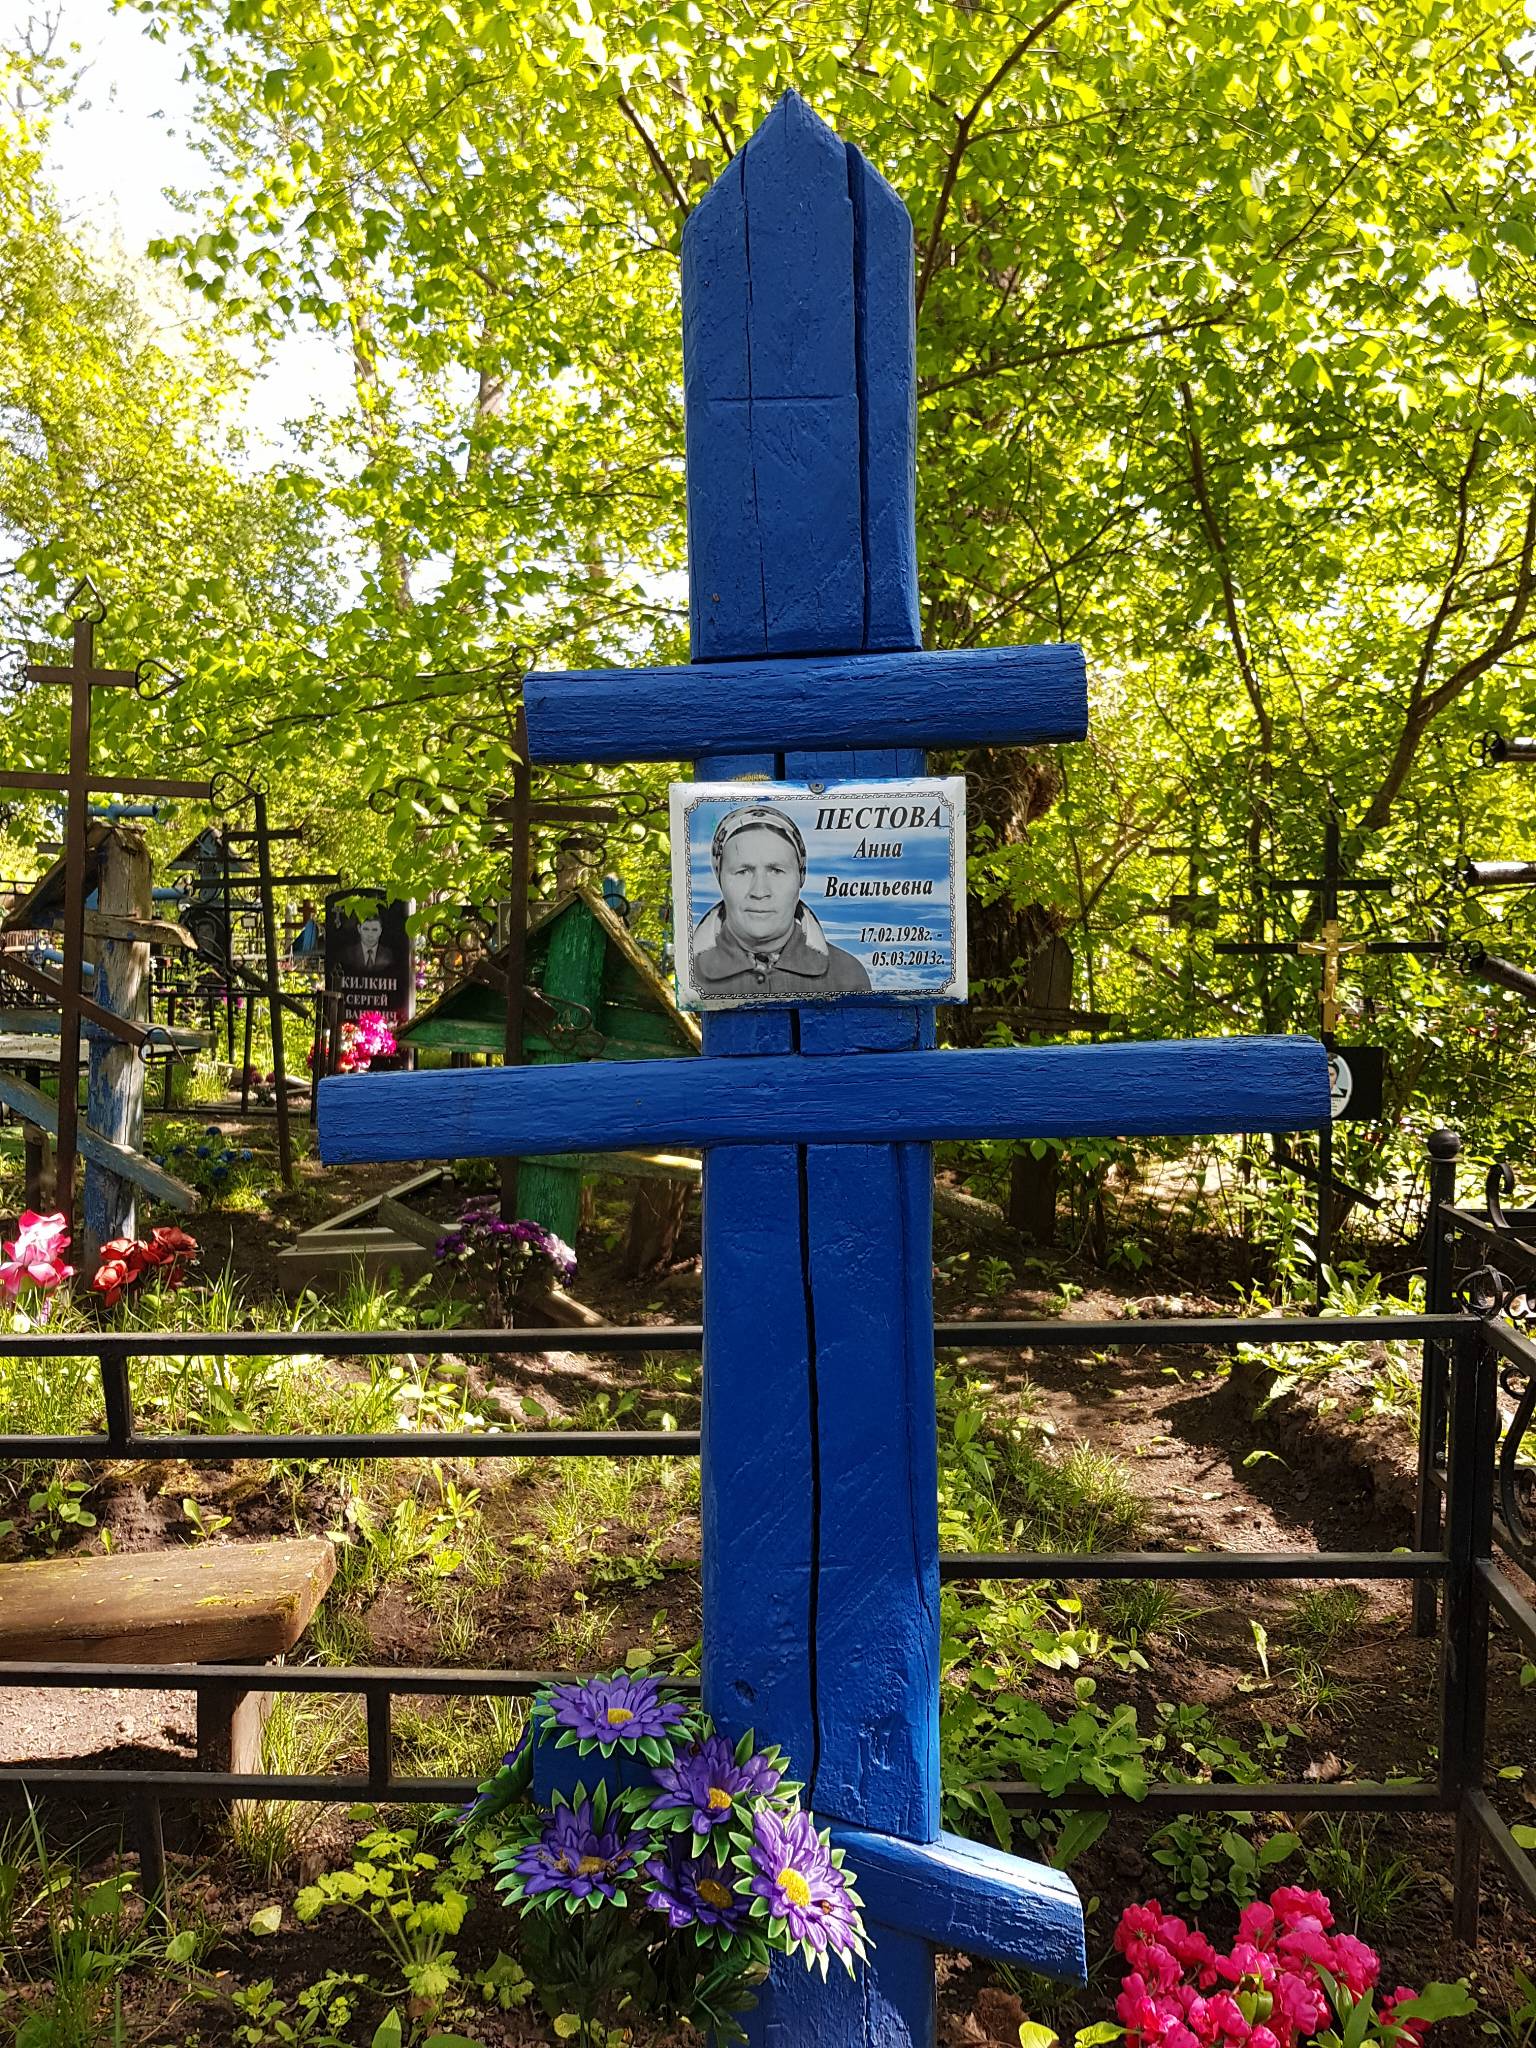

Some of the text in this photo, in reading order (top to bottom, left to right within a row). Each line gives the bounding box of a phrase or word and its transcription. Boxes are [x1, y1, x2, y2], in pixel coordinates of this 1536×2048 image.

[814, 806, 942, 831] ПЕСТОВА
[853, 837, 903, 859] Анна
[823, 876, 933, 898] Васильевна
[859, 927, 933, 943] 17.02.1928г.
[871, 950, 945, 967] 05.03.2013г.
[346, 993, 388, 1006] СЕРГЕЙ
